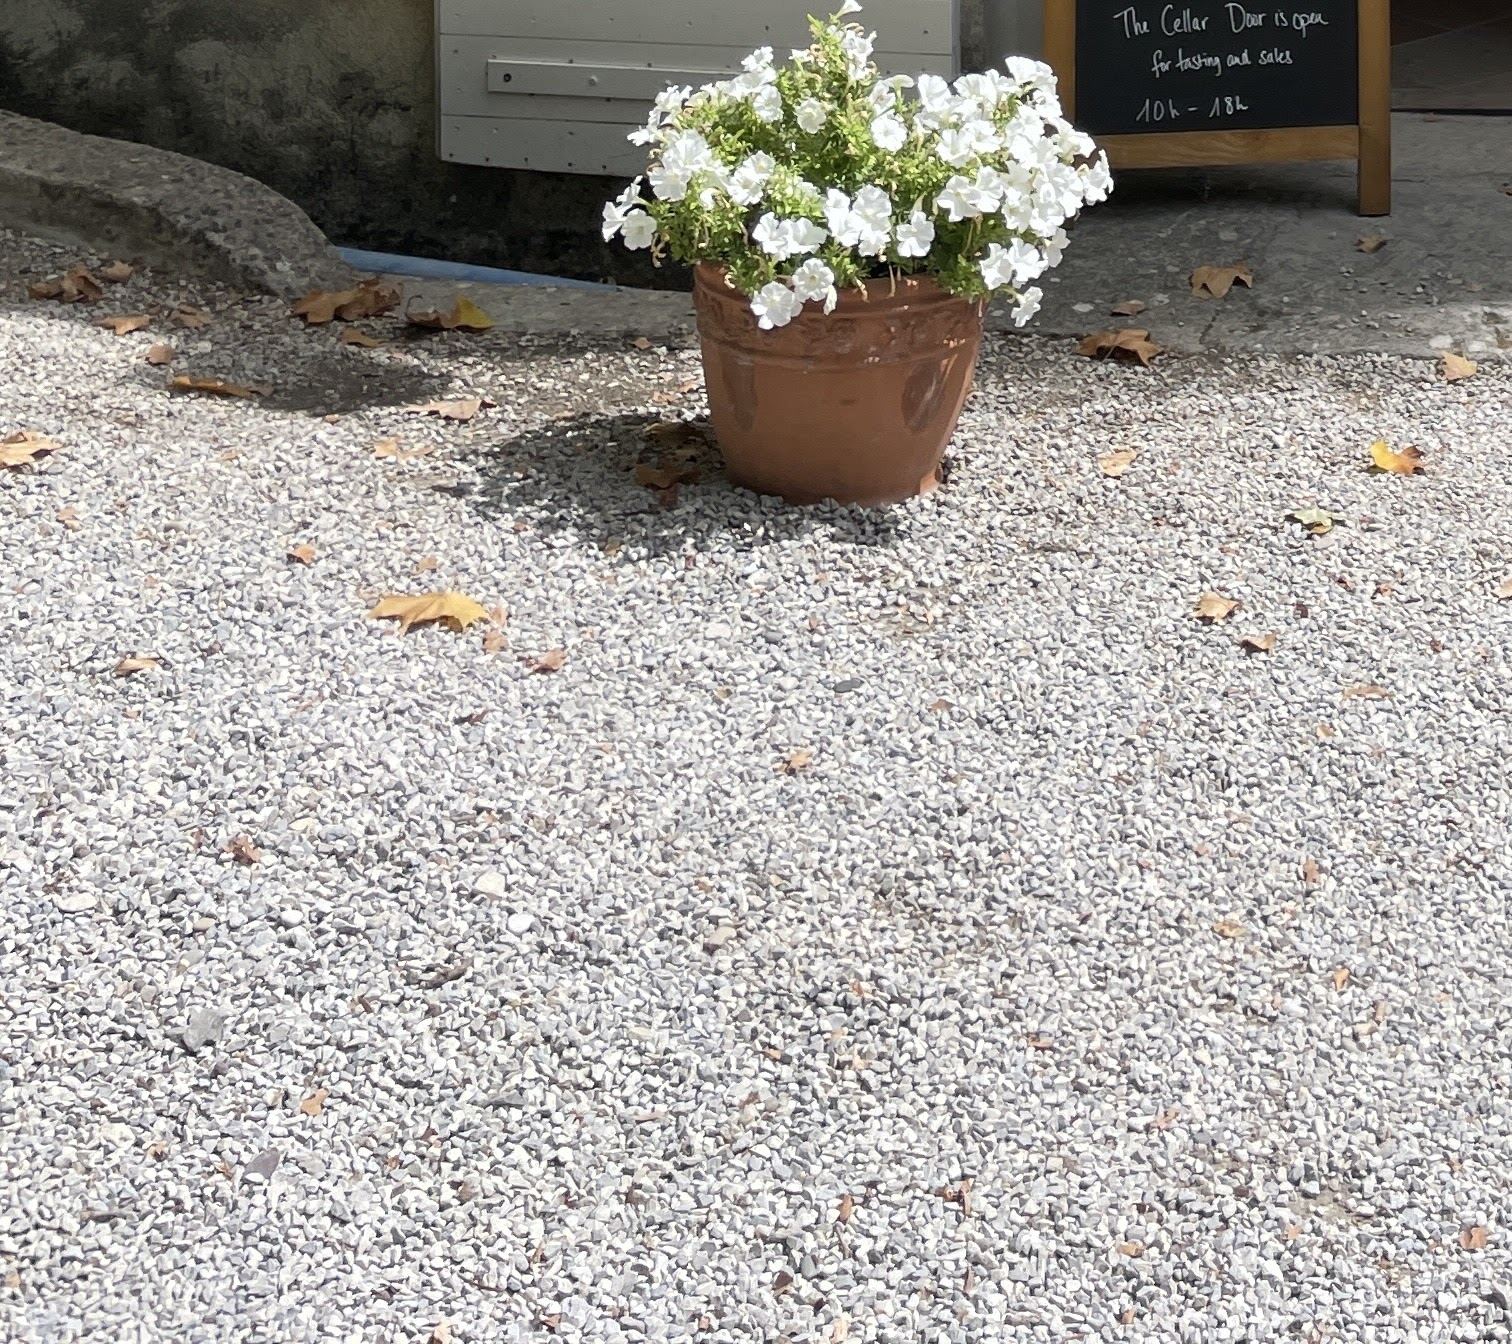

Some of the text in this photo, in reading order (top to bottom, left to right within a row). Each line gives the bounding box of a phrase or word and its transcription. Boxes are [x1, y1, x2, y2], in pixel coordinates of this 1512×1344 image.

[1113, 2, 1329, 39] The Cellar Door is open
[1151, 47, 1293, 79] for tasting and sales
[1135, 99, 1180, 123] 10h
[1208, 96, 1249, 118] 18h
